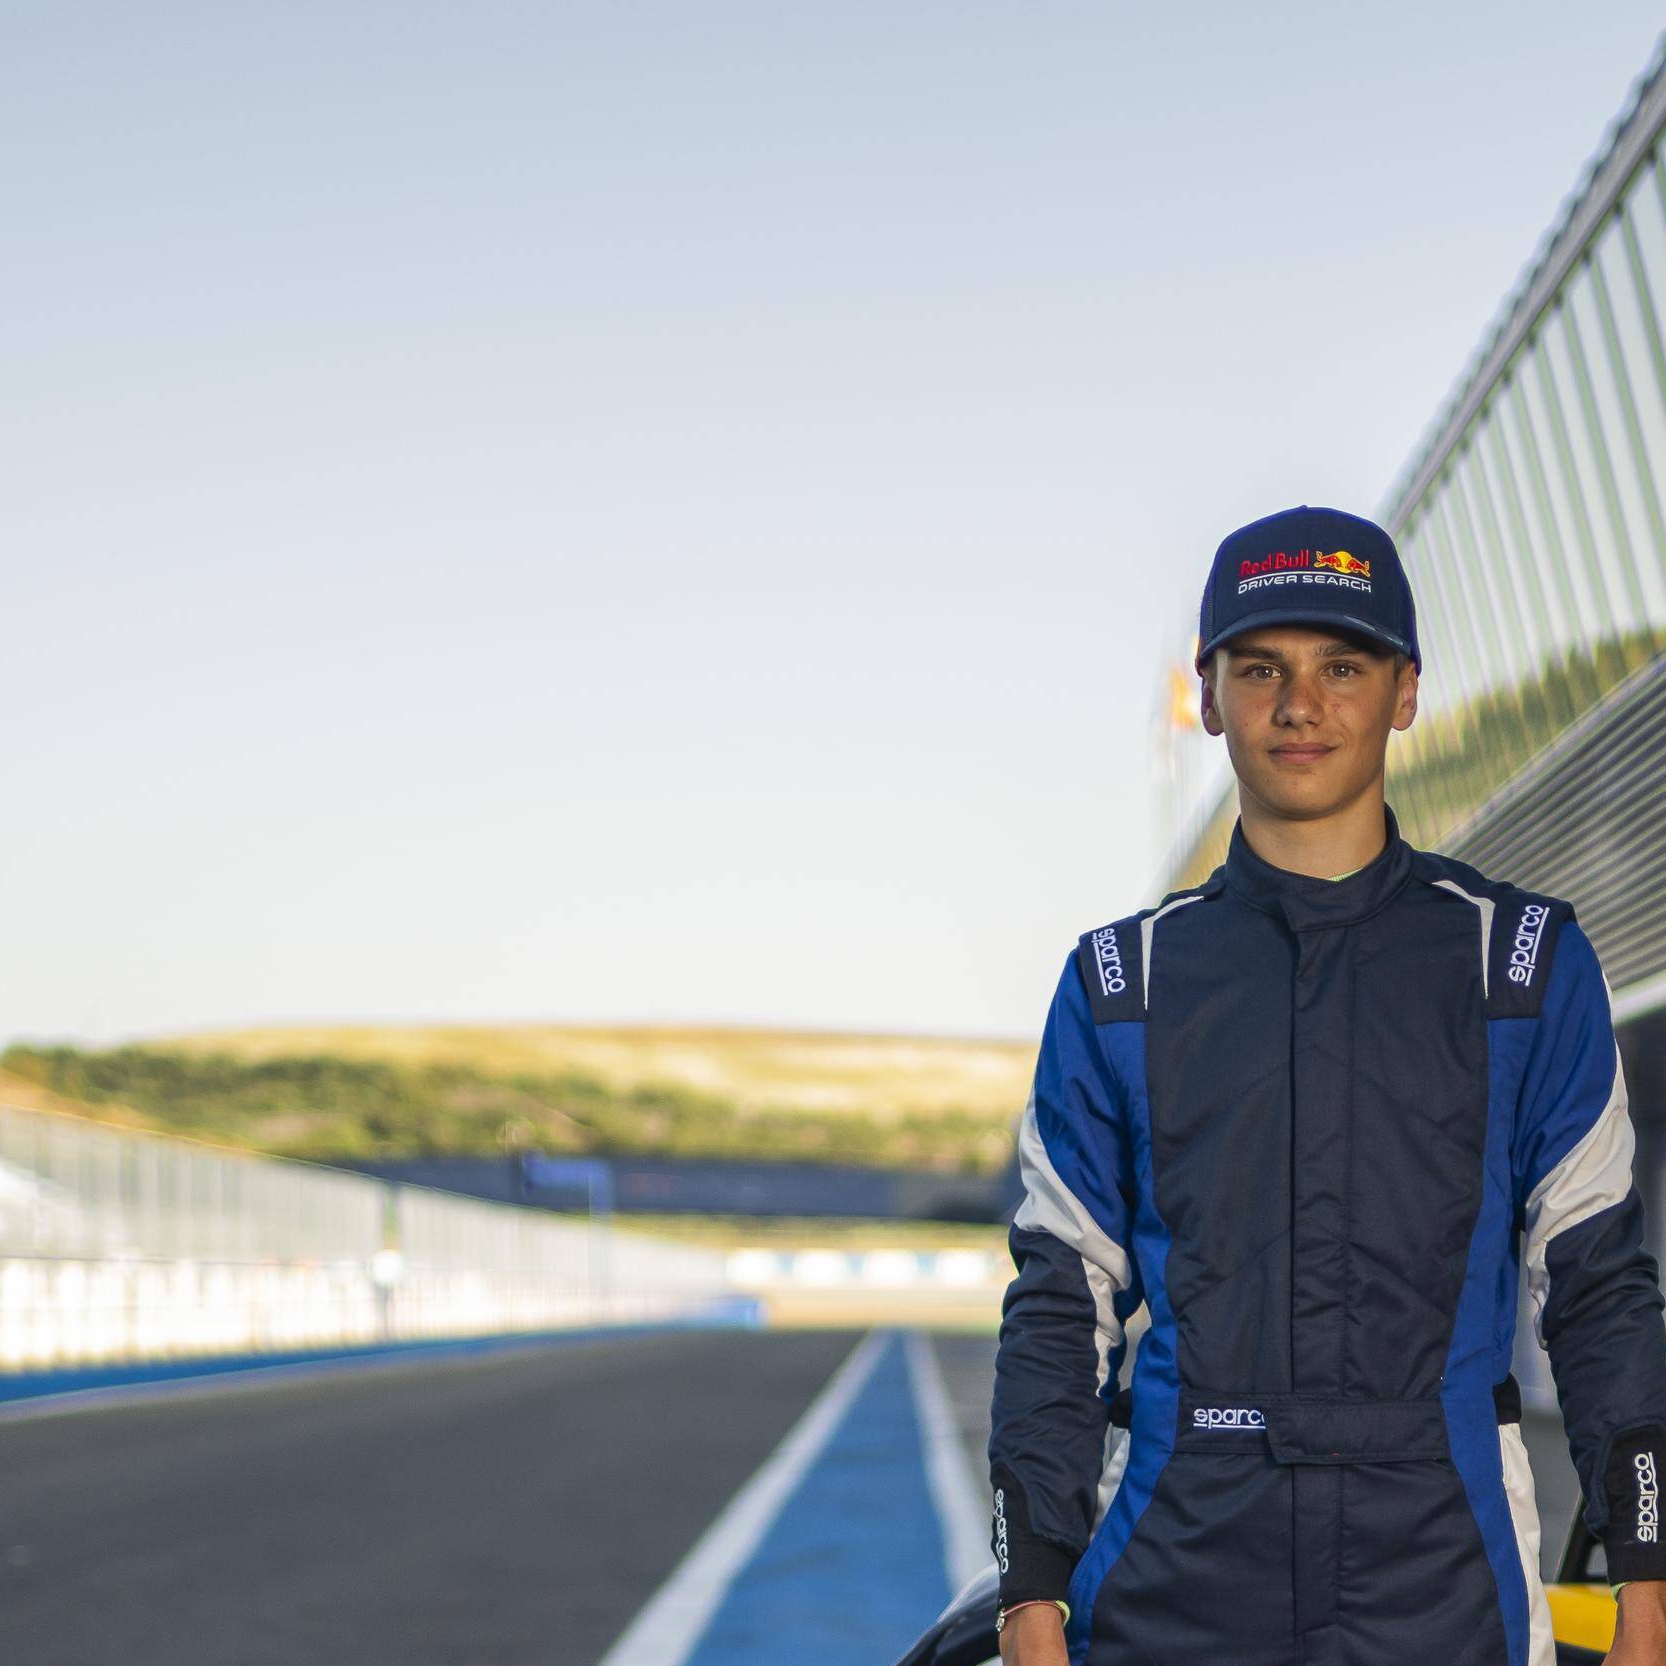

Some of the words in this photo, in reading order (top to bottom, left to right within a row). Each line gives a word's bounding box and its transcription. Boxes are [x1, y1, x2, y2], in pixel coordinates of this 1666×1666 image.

[1238, 552, 1272, 578] Red
[1274, 549, 1310, 570] Bull
[1238, 574, 1298, 594] DRIVER
[1302, 574, 1372, 593] SEARCH
[1092, 927, 1126, 996] sparco
[1507, 904, 1550, 986] sparco
[1634, 1452, 1658, 1543] sparco
